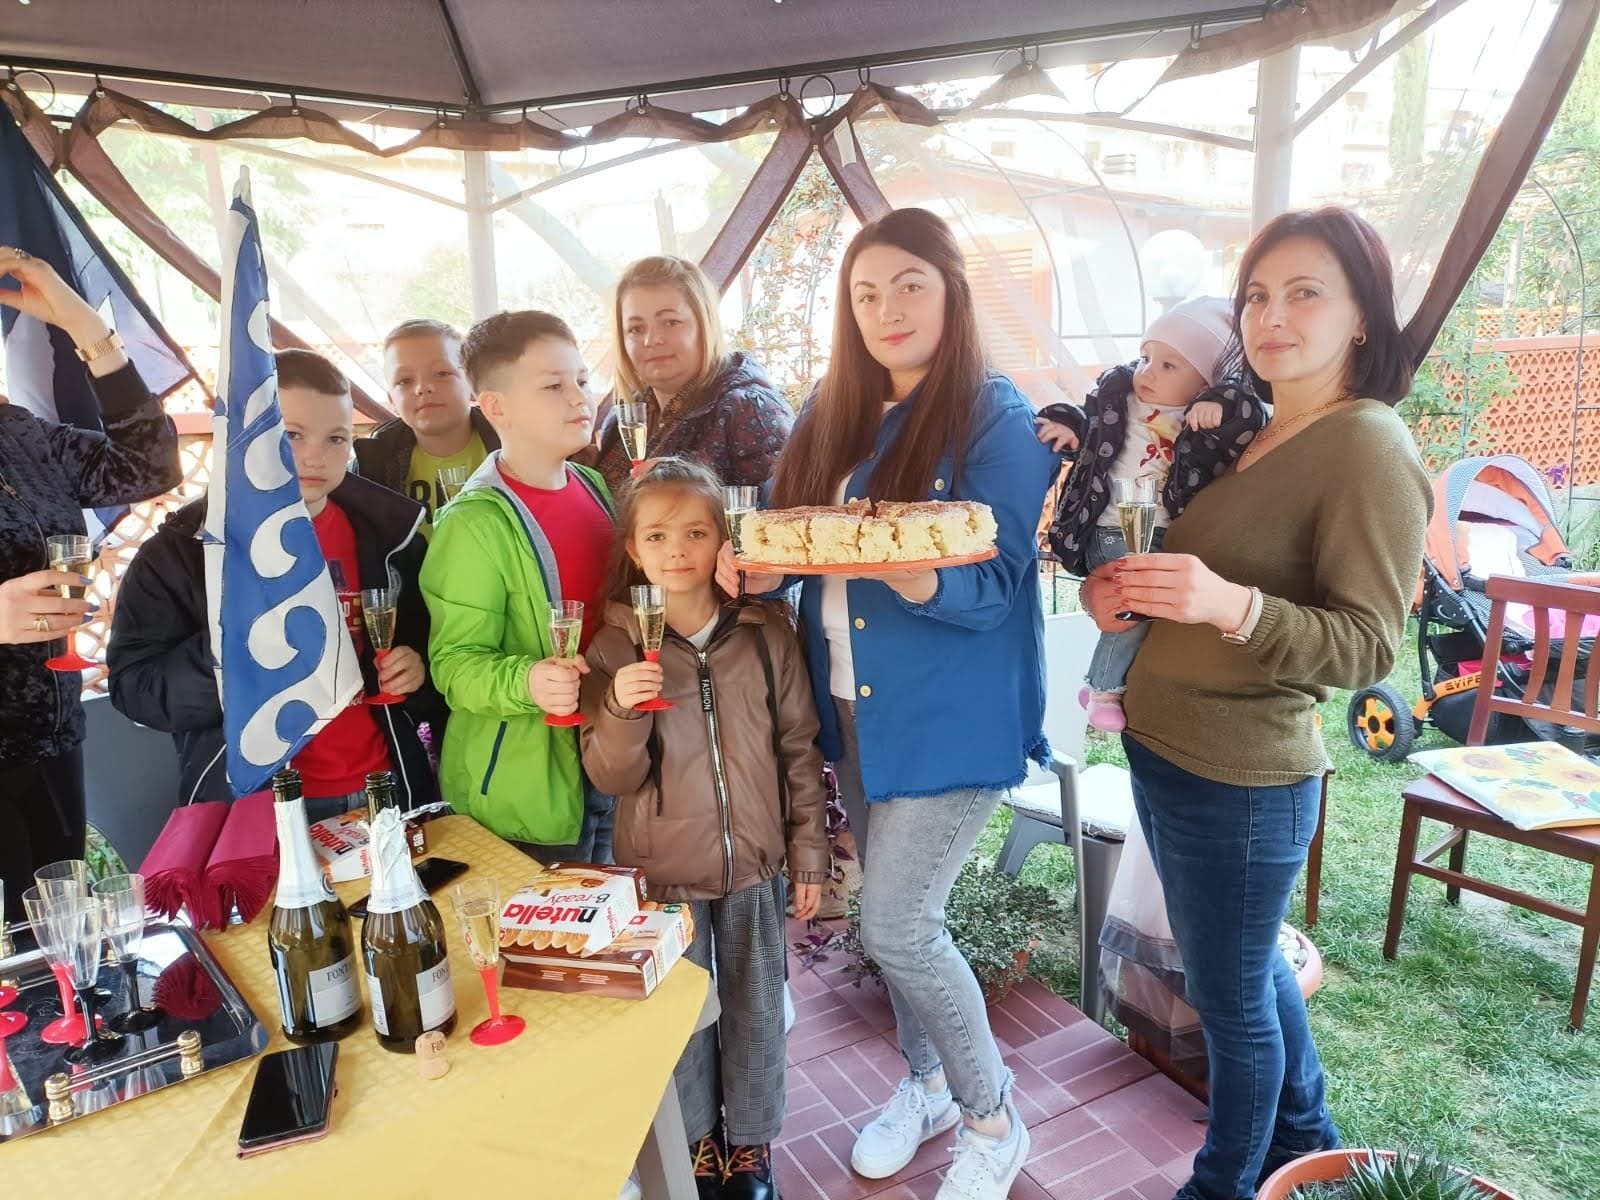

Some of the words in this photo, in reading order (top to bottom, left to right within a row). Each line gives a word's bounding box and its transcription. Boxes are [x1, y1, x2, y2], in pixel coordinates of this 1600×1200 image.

[701, 679, 712, 711] FASHION
[309, 823, 353, 855] nutella
[544, 893, 610, 905] B-ready
[503, 903, 598, 925] nutella
